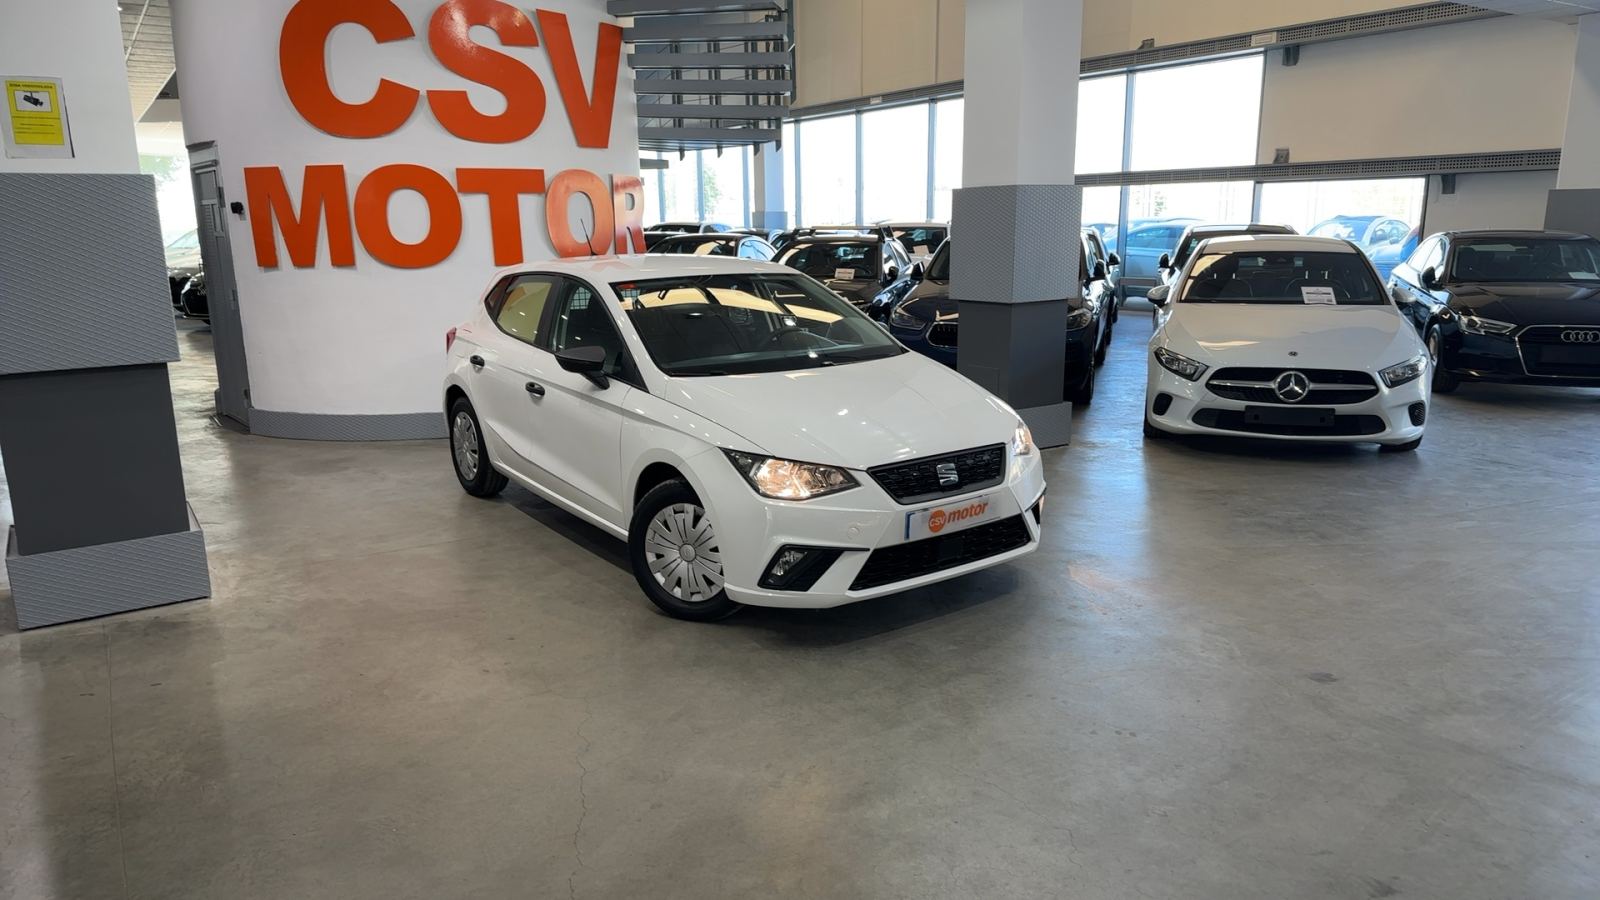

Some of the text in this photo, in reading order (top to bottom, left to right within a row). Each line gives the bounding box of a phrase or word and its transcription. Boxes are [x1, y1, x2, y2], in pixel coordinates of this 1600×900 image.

[279, 0, 623, 148] CSV
[243, 163, 646, 268] MOTOR
[947, 502, 988, 523] motor
